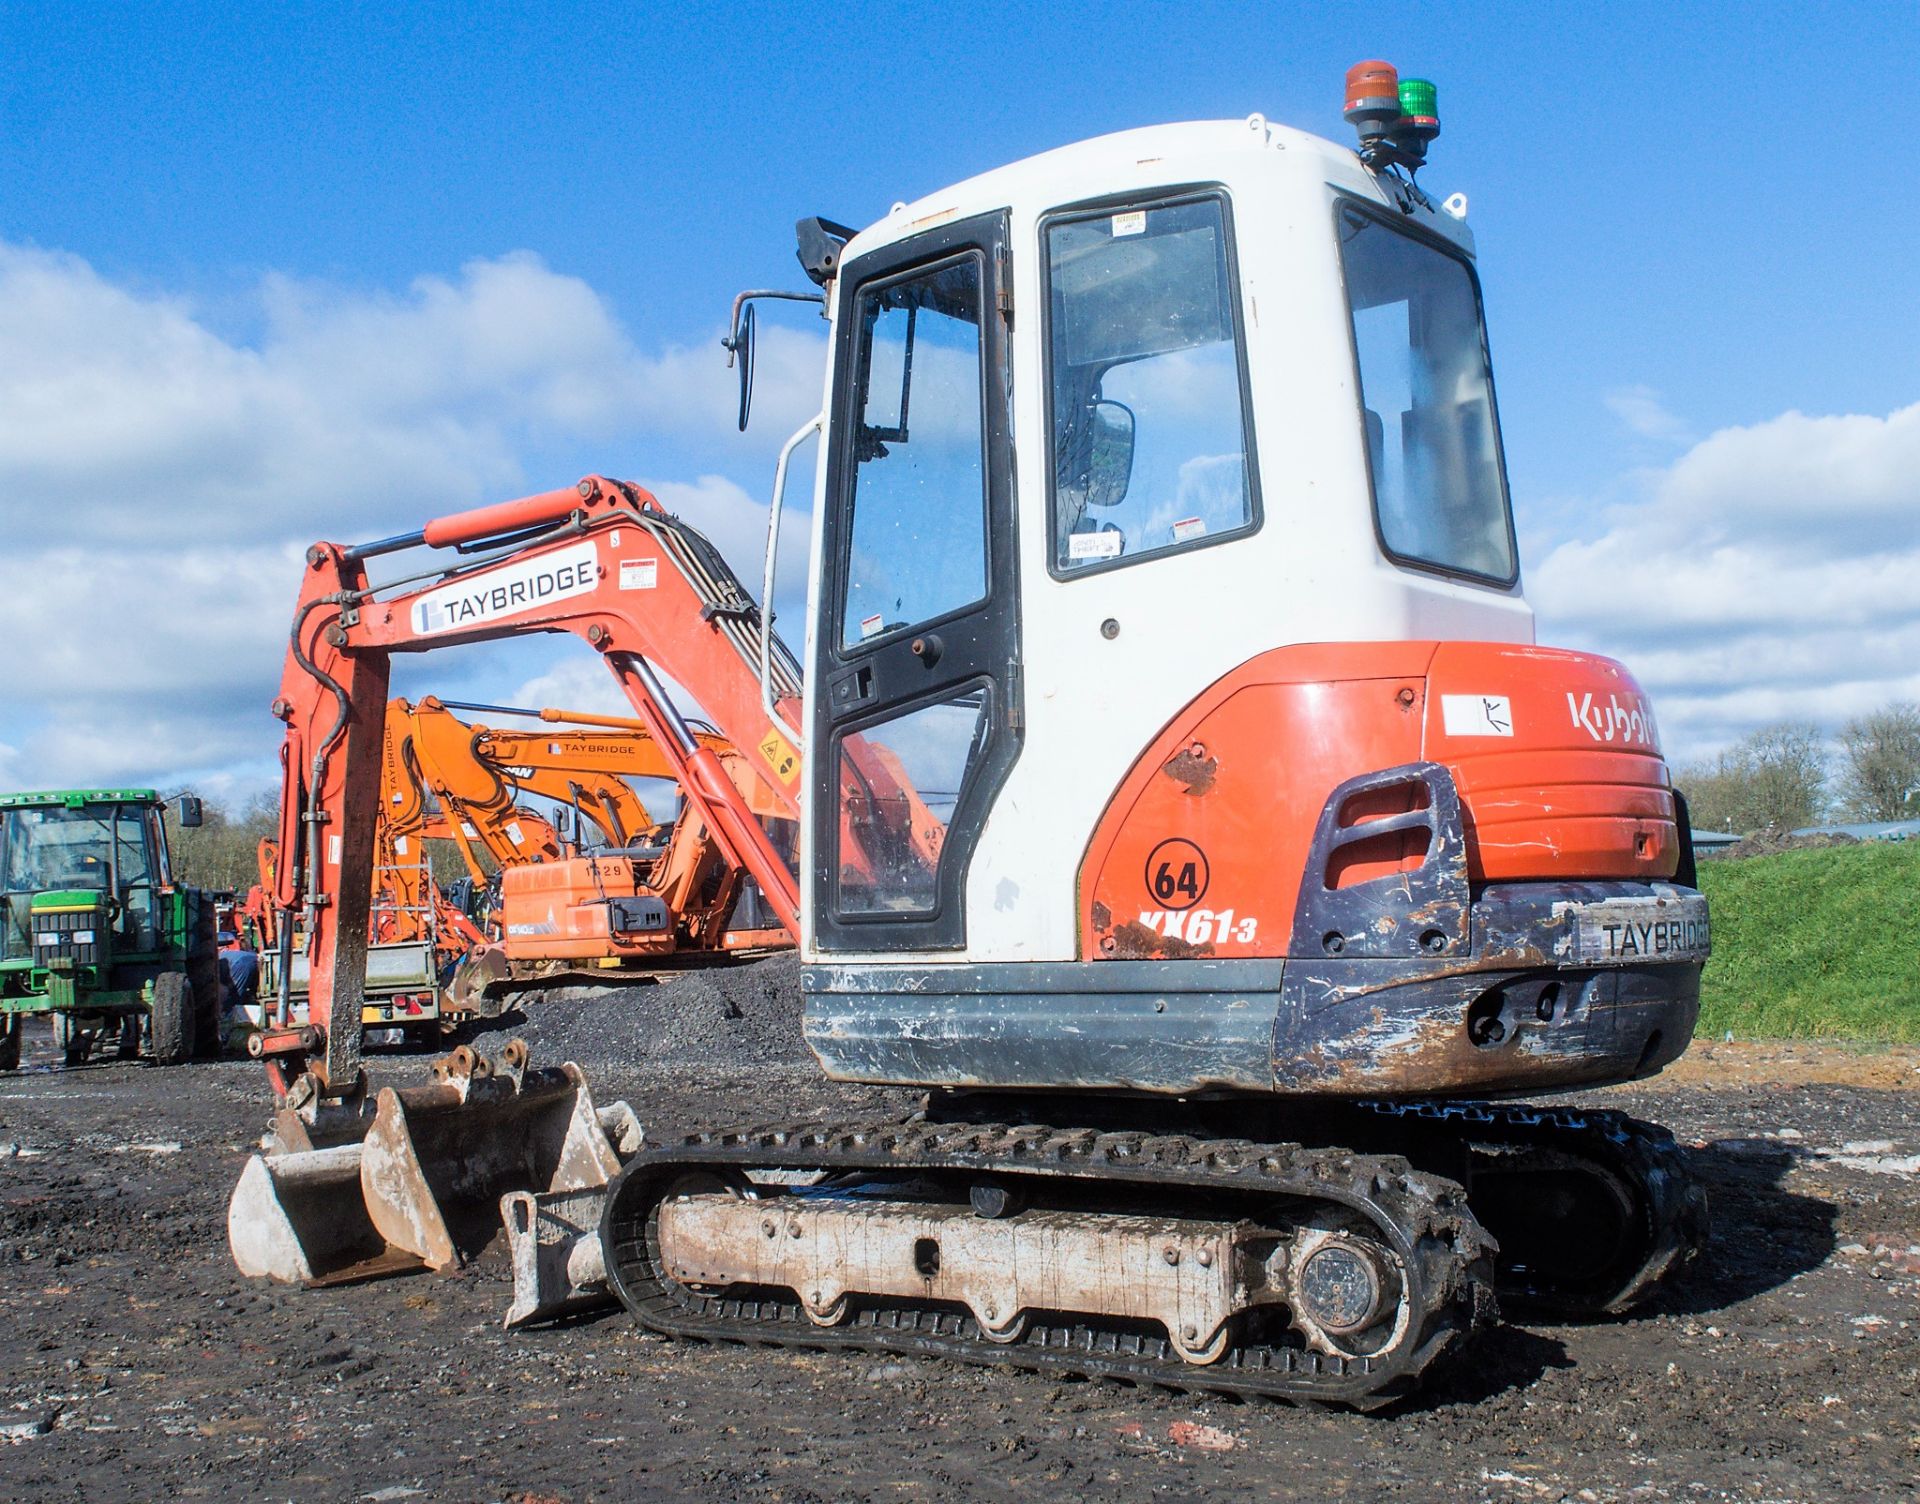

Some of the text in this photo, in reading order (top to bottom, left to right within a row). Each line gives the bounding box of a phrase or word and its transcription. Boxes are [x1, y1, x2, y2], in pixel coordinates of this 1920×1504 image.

[444, 560, 594, 624] TAYBRIDGE
[385, 723, 398, 791] TAYBRIDGE
[564, 743, 636, 754] TAYBRIDGE
[1154, 861, 1198, 899] 64
